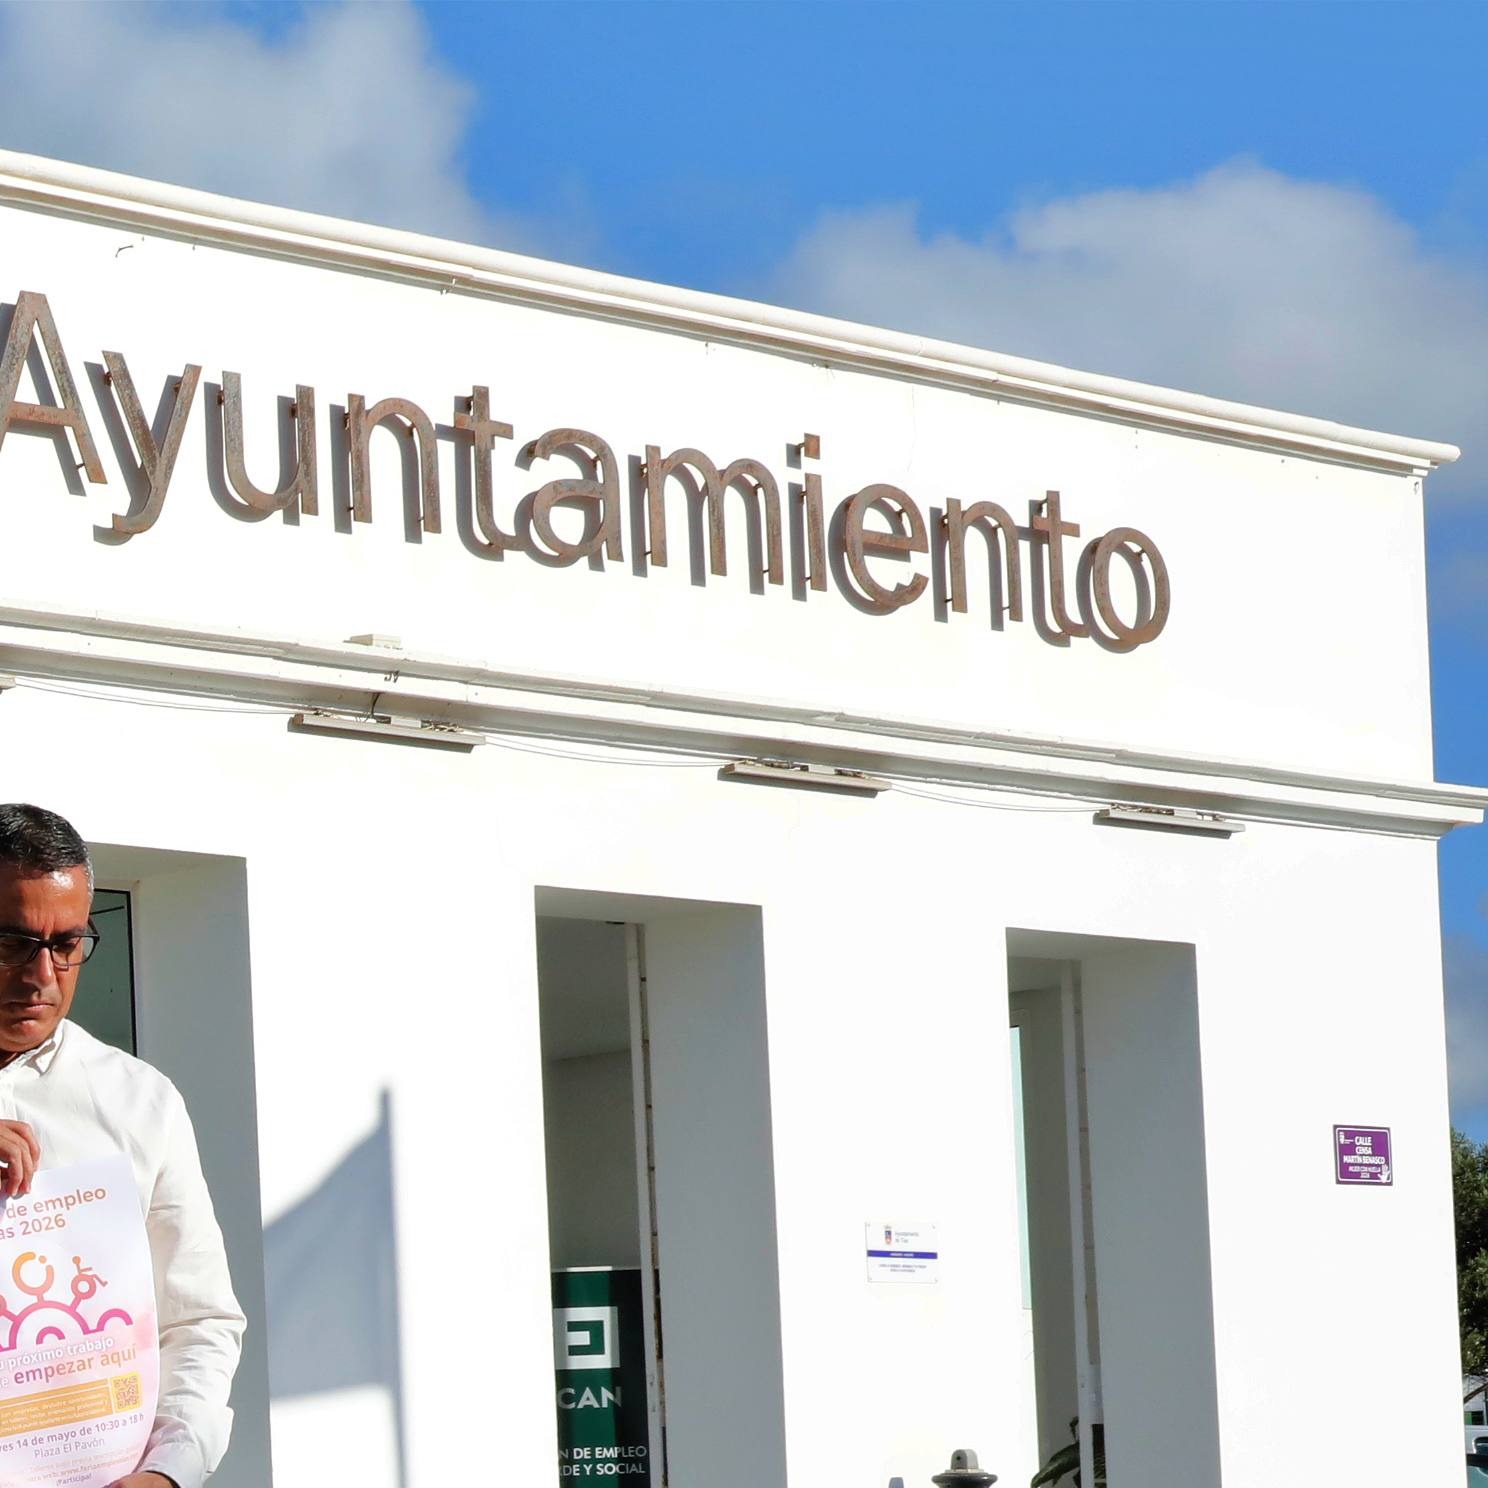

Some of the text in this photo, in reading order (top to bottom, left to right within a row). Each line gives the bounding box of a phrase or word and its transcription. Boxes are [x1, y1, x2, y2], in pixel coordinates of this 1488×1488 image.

[6, 1204, 27, 1219] de
[33, 1188, 106, 1210] empleo
[20, 1213, 66, 1236] 2026
[7, 1348, 64, 1369] próximo
[67, 1337, 114, 1355] trabajo
[14, 1358, 94, 1384] empezar
[100, 1345, 137, 1368] aquí
[16, 1439, 28, 1449] 14
[31, 1436, 44, 1447] de
[46, 1430, 77, 1443] mayo
[80, 1426, 92, 1437] de
[95, 1420, 120, 1433] 10:30
[121, 1419, 127, 1427] a
[129, 1415, 138, 1425] 18
[139, 1413, 144, 1422] h
[34, 1438, 104, 1458] Plaza El Pavón
[573, 1448, 592, 1459] DE
[595, 1446, 647, 1459] EMPLEO
[560, 1463, 646, 1476] DE Y SOCIAL
